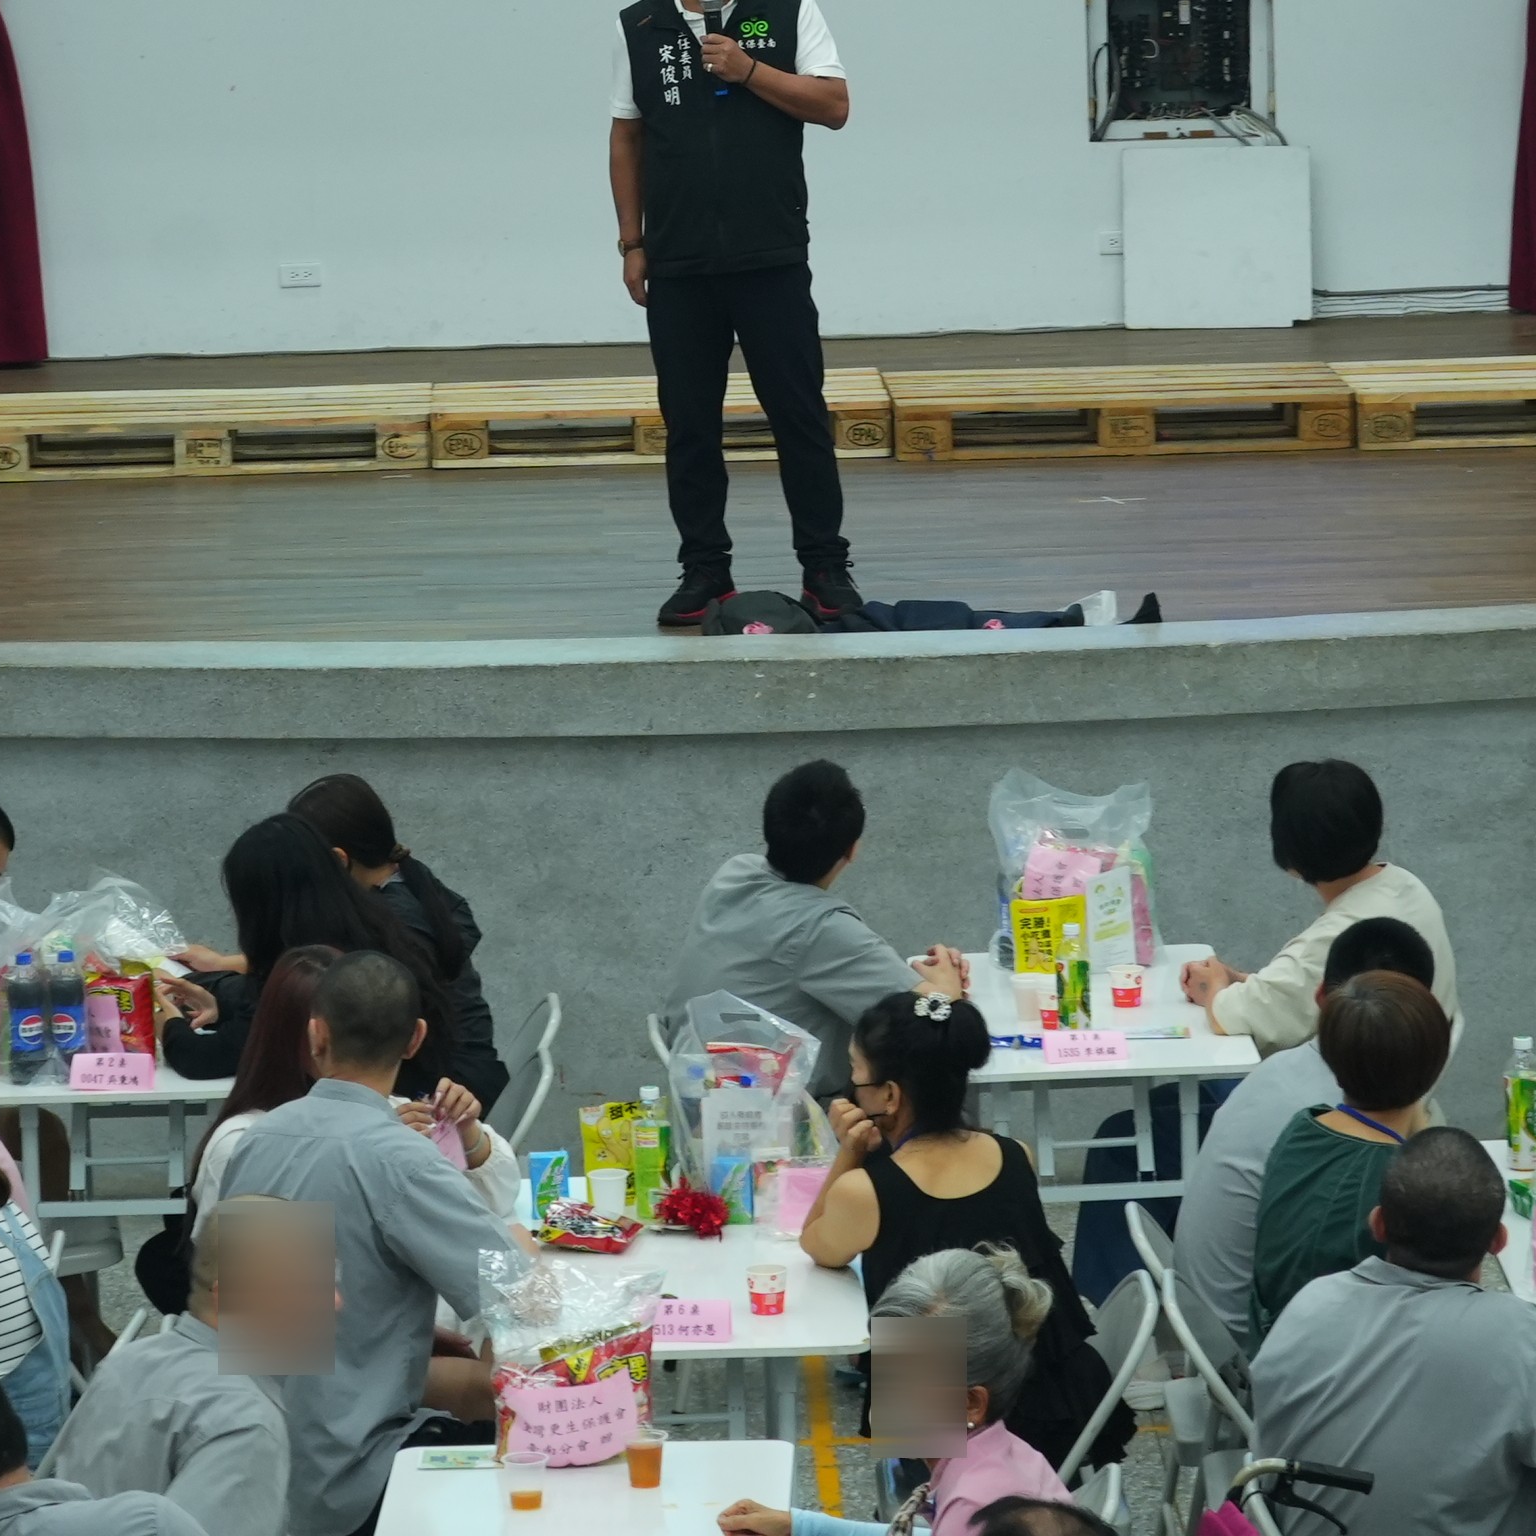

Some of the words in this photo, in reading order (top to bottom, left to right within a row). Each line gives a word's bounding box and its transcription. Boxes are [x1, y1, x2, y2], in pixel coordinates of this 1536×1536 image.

[658, 44, 682, 107] 宋俊明
[537, 1395, 604, 1414] 財團法人
